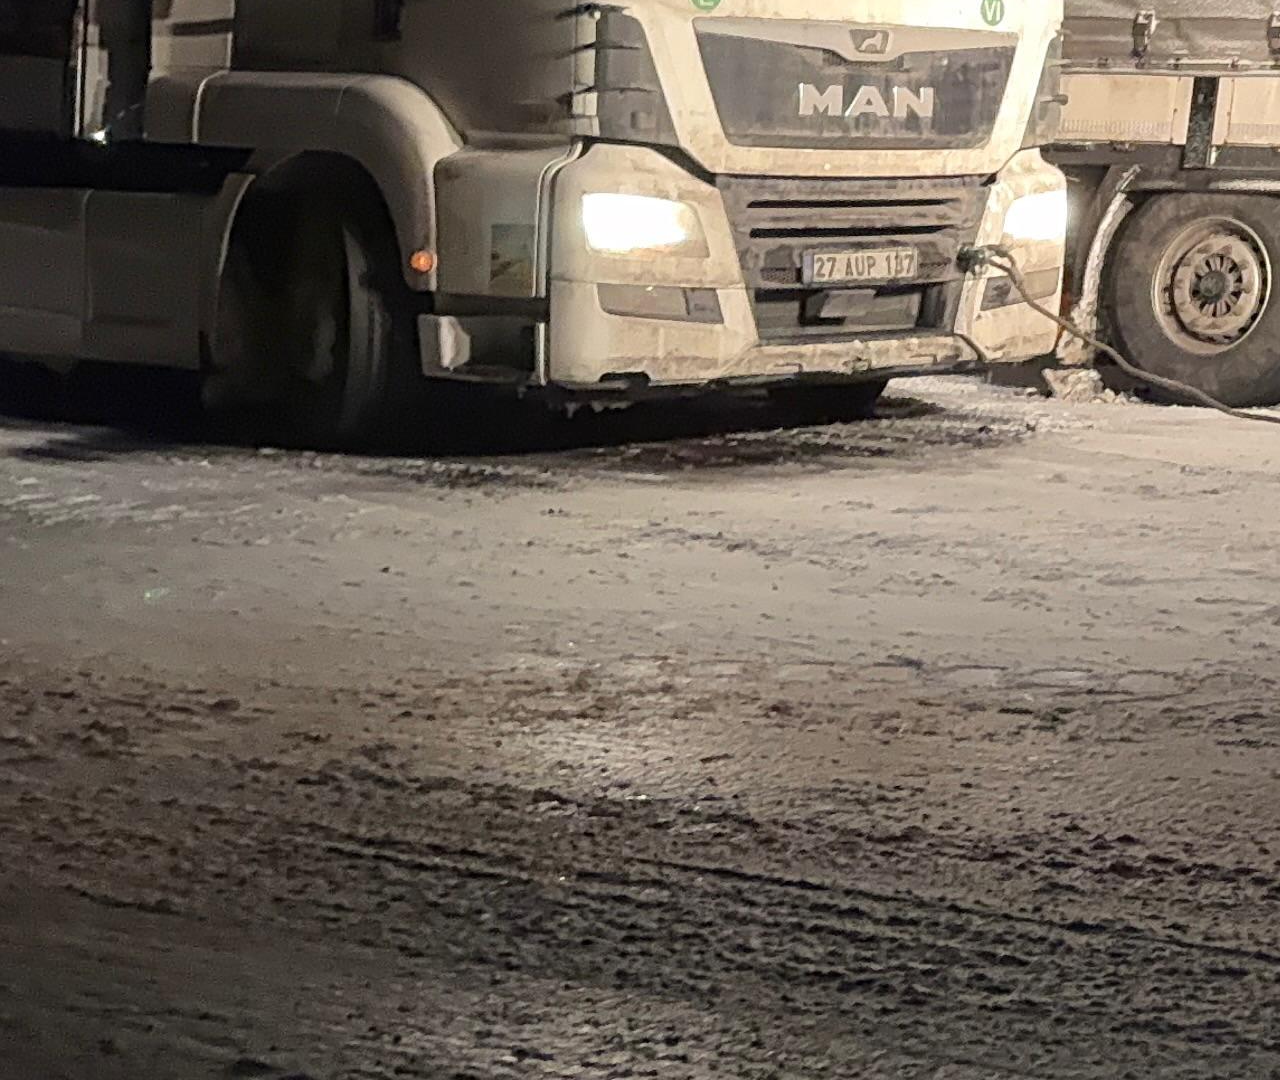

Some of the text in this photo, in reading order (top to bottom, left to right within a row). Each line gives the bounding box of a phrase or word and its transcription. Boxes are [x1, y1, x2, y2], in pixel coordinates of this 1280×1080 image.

[798, 82, 935, 118] MAN
[815, 256, 837, 279] 27
[845, 255, 876, 276] AUP
